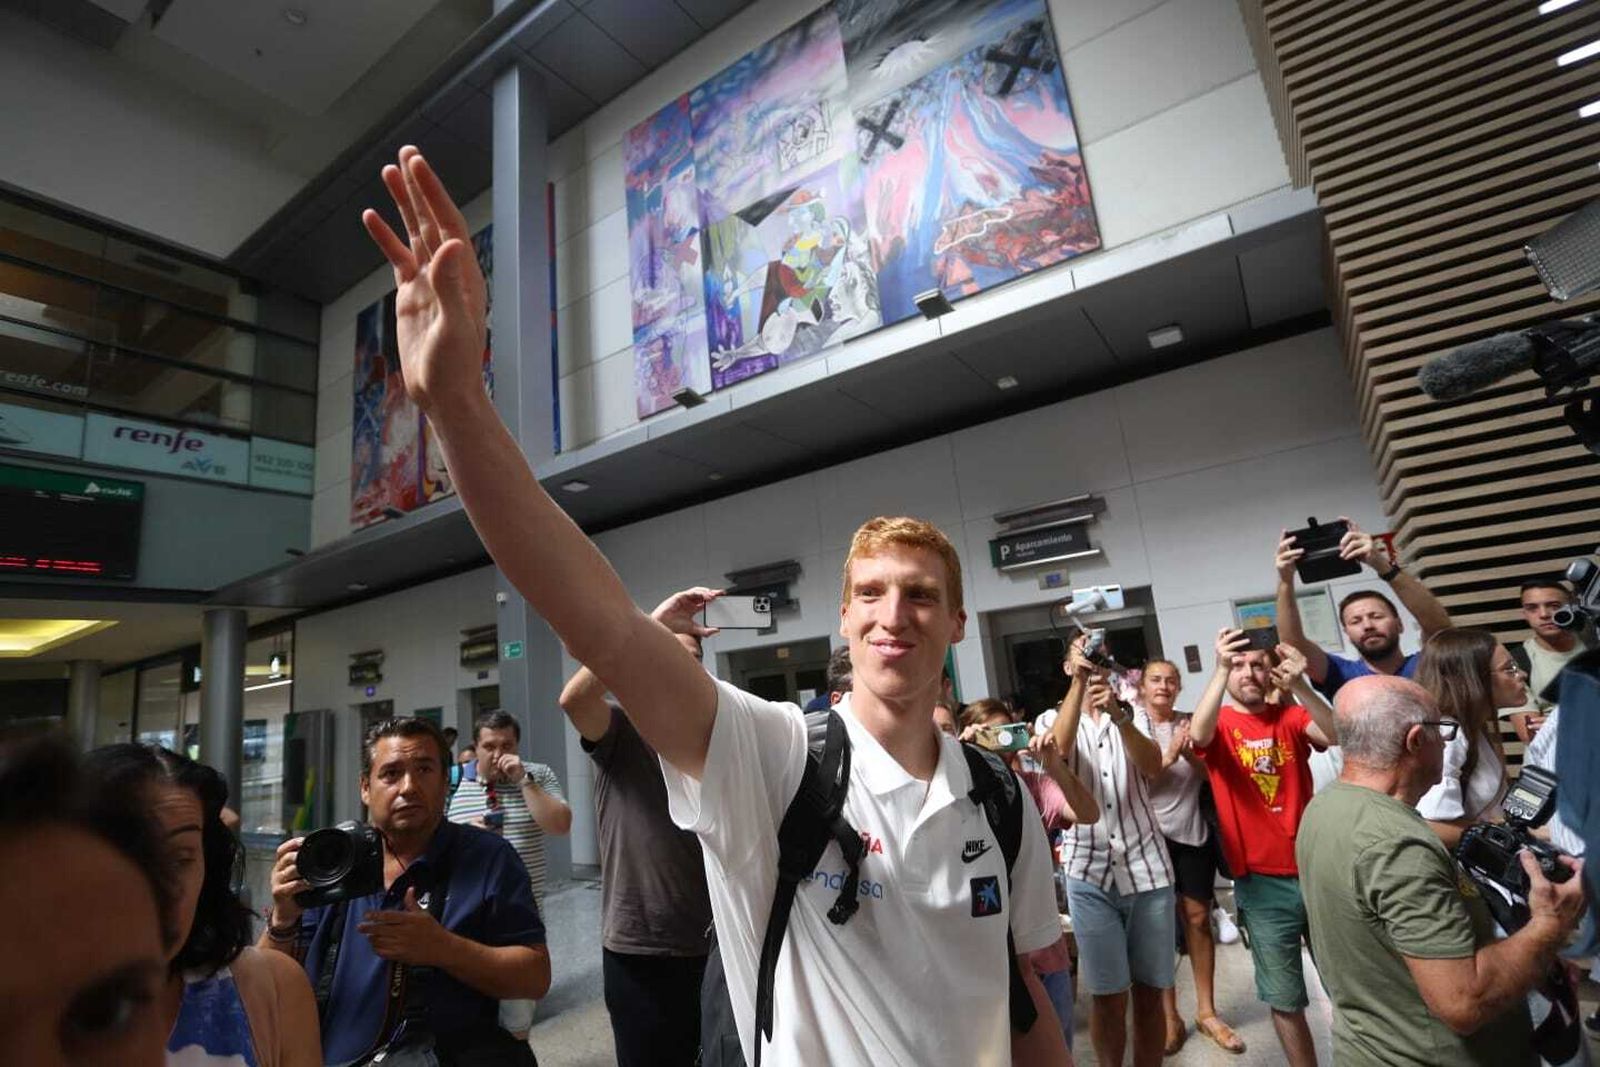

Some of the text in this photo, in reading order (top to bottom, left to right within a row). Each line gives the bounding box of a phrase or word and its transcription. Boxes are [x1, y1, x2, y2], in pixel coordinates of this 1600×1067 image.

[113, 426, 204, 454] renfe
[1001, 545, 1010, 560] P
[1015, 533, 1073, 552] Aparcamiento
[965, 840, 985, 853] NIKE
